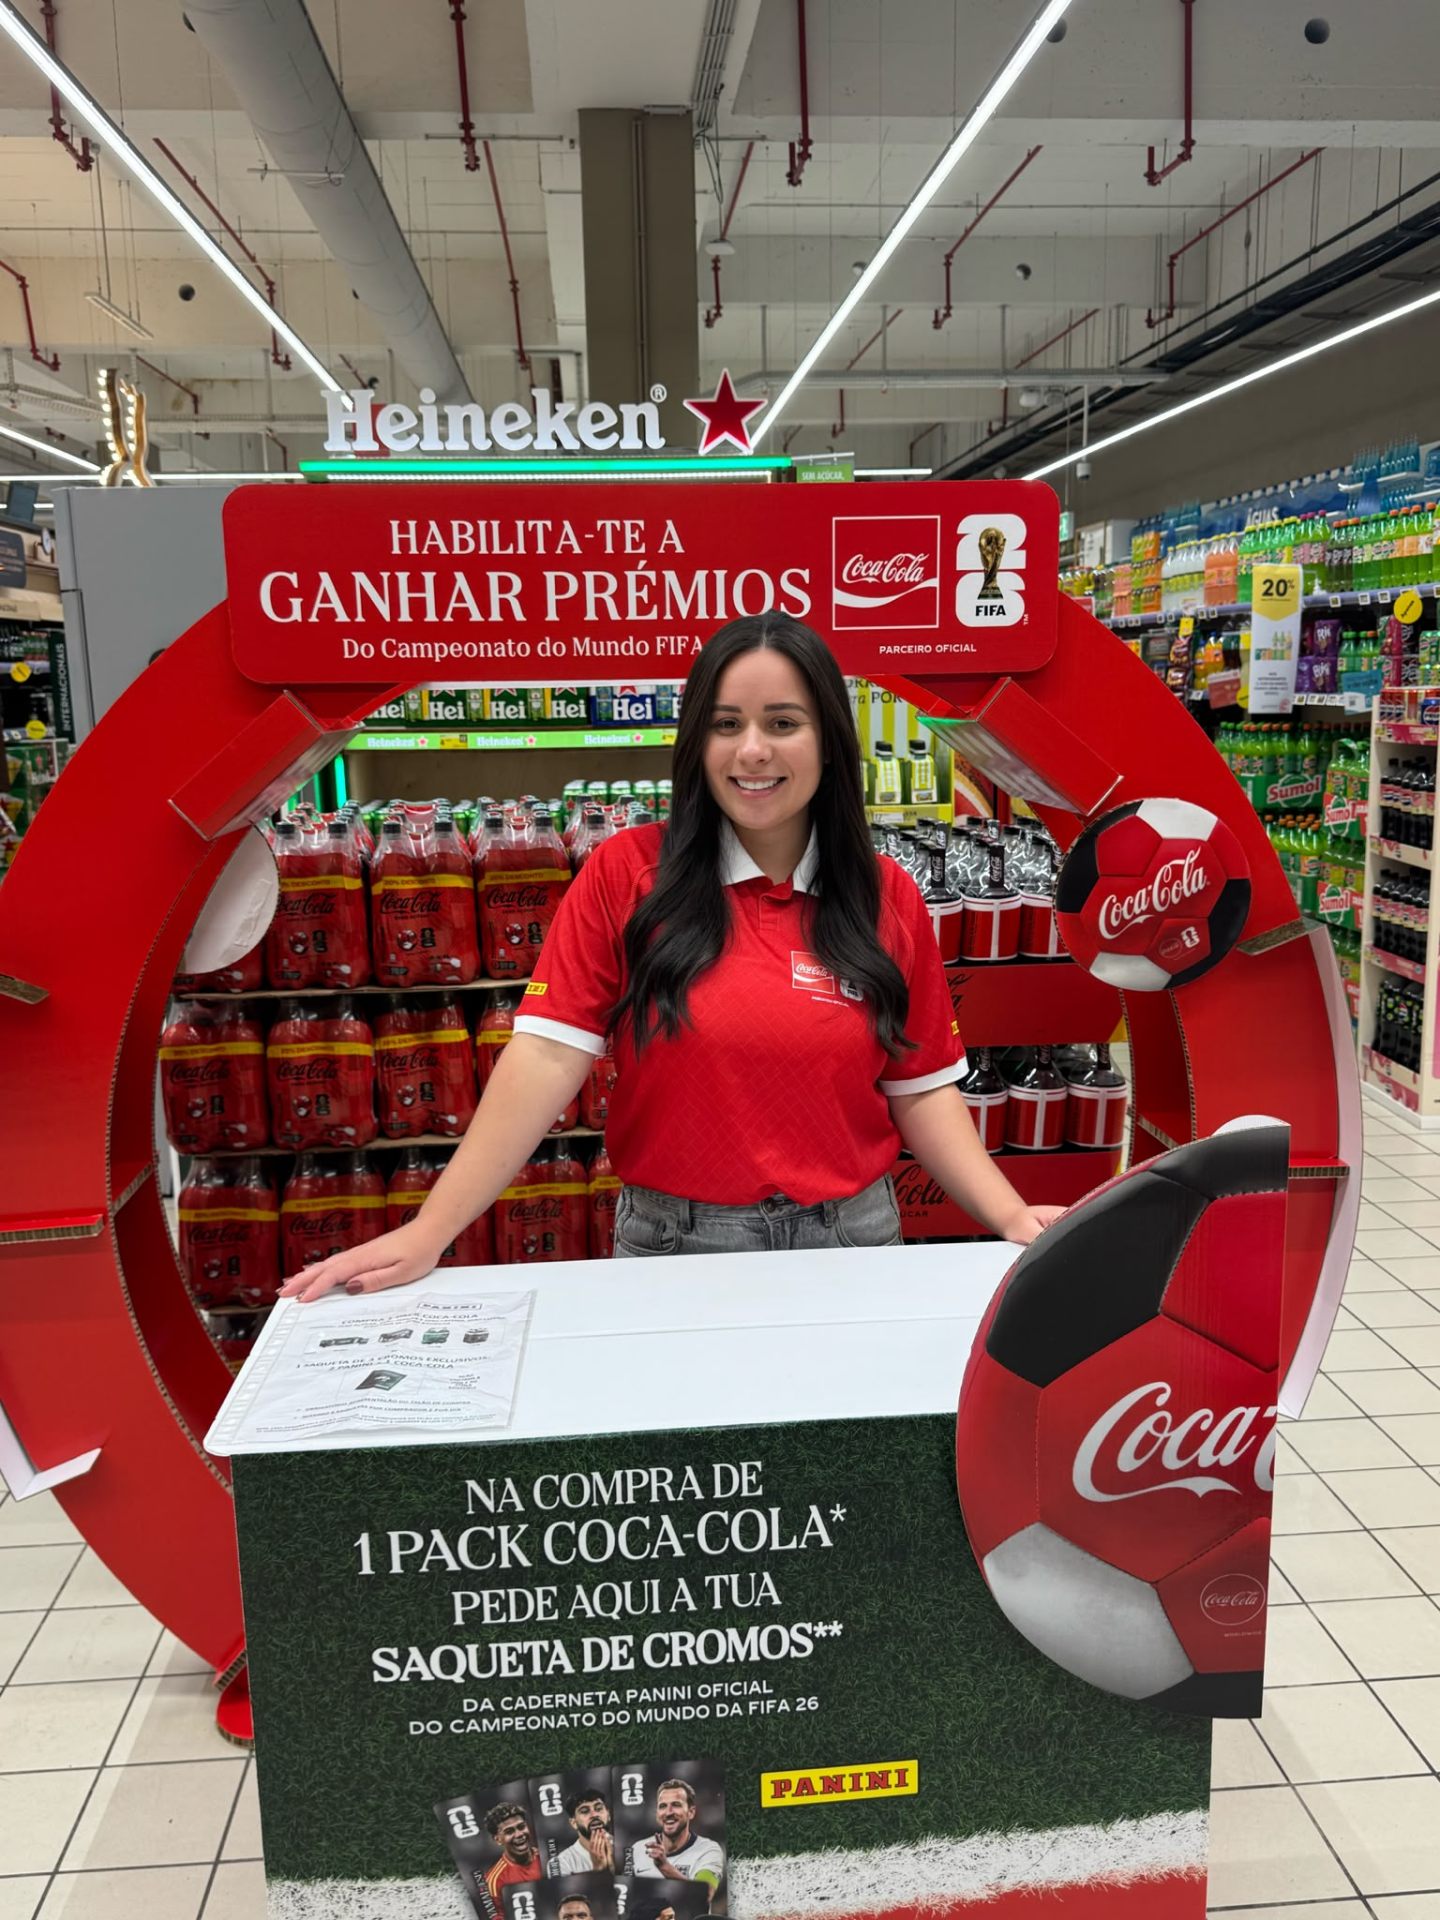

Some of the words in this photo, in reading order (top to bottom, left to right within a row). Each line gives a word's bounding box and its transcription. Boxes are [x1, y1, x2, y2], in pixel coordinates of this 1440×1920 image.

[390, 520, 646, 555] HABILITA-TE
[658, 520, 685, 554] A
[842, 553, 930, 584] Coca-Cola
[259, 571, 527, 623] GANHAR
[543, 560, 812, 622] PRÉMIOS
[975, 604, 1006, 617] FIFA
[343, 637, 375, 659] Do
[381, 637, 531, 661] Campeonato
[538, 636, 567, 658] do
[572, 635, 649, 658] Mundo
[656, 635, 702, 655] FIFA
[879, 644, 932, 655] PARCEIRO
[935, 643, 976, 653] OFICIAL
[56, 643, 72, 732] INTERNACIONAIS
[429, 701, 465, 720] Hei
[490, 700, 526, 719] Hei
[552, 700, 587, 718] Hei
[613, 698, 653, 721] Hei
[367, 736, 416, 748] Heineken
[477, 735, 524, 747] Heineken
[584, 734, 630, 745] Heineken
[1267, 776, 1323, 804] Sumol
[1323, 801, 1358, 826] Sumol
[279, 892, 337, 915] oca-Cola
[1098, 846, 1209, 940] Coca-Cola
[1319, 890, 1352, 913] Sumol
[394, 1360, 455, 1369] COCA-COLA
[465, 1477, 525, 1515] NA
[533, 1465, 704, 1511] COMPRA
[712, 1460, 763, 1499] DE
[353, 1532, 376, 1575] 1
[387, 1523, 533, 1574] PACK
[451, 1586, 559, 1626] PEDE
[567, 1578, 662, 1621] AQUI
[670, 1577, 698, 1613] A
[704, 1571, 783, 1610] TUA
[371, 1636, 574, 1684] SAQUETA
[582, 1633, 635, 1673] DE
[463, 1698, 495, 1713] DA
[500, 1690, 621, 1711] CADERNETA
[626, 1684, 693, 1702] PANINI
[698, 1679, 774, 1699] OFICIAL
[409, 1720, 443, 1735] DO
[449, 1712, 597, 1734] CAMPEONATO
[602, 1709, 631, 1725] DO
[636, 1704, 710, 1723] MUNDO
[716, 1702, 743, 1718] DA
[748, 1699, 790, 1716] FIFA
[795, 1696, 819, 1712] 26
[770, 1768, 910, 1799] PANINI
